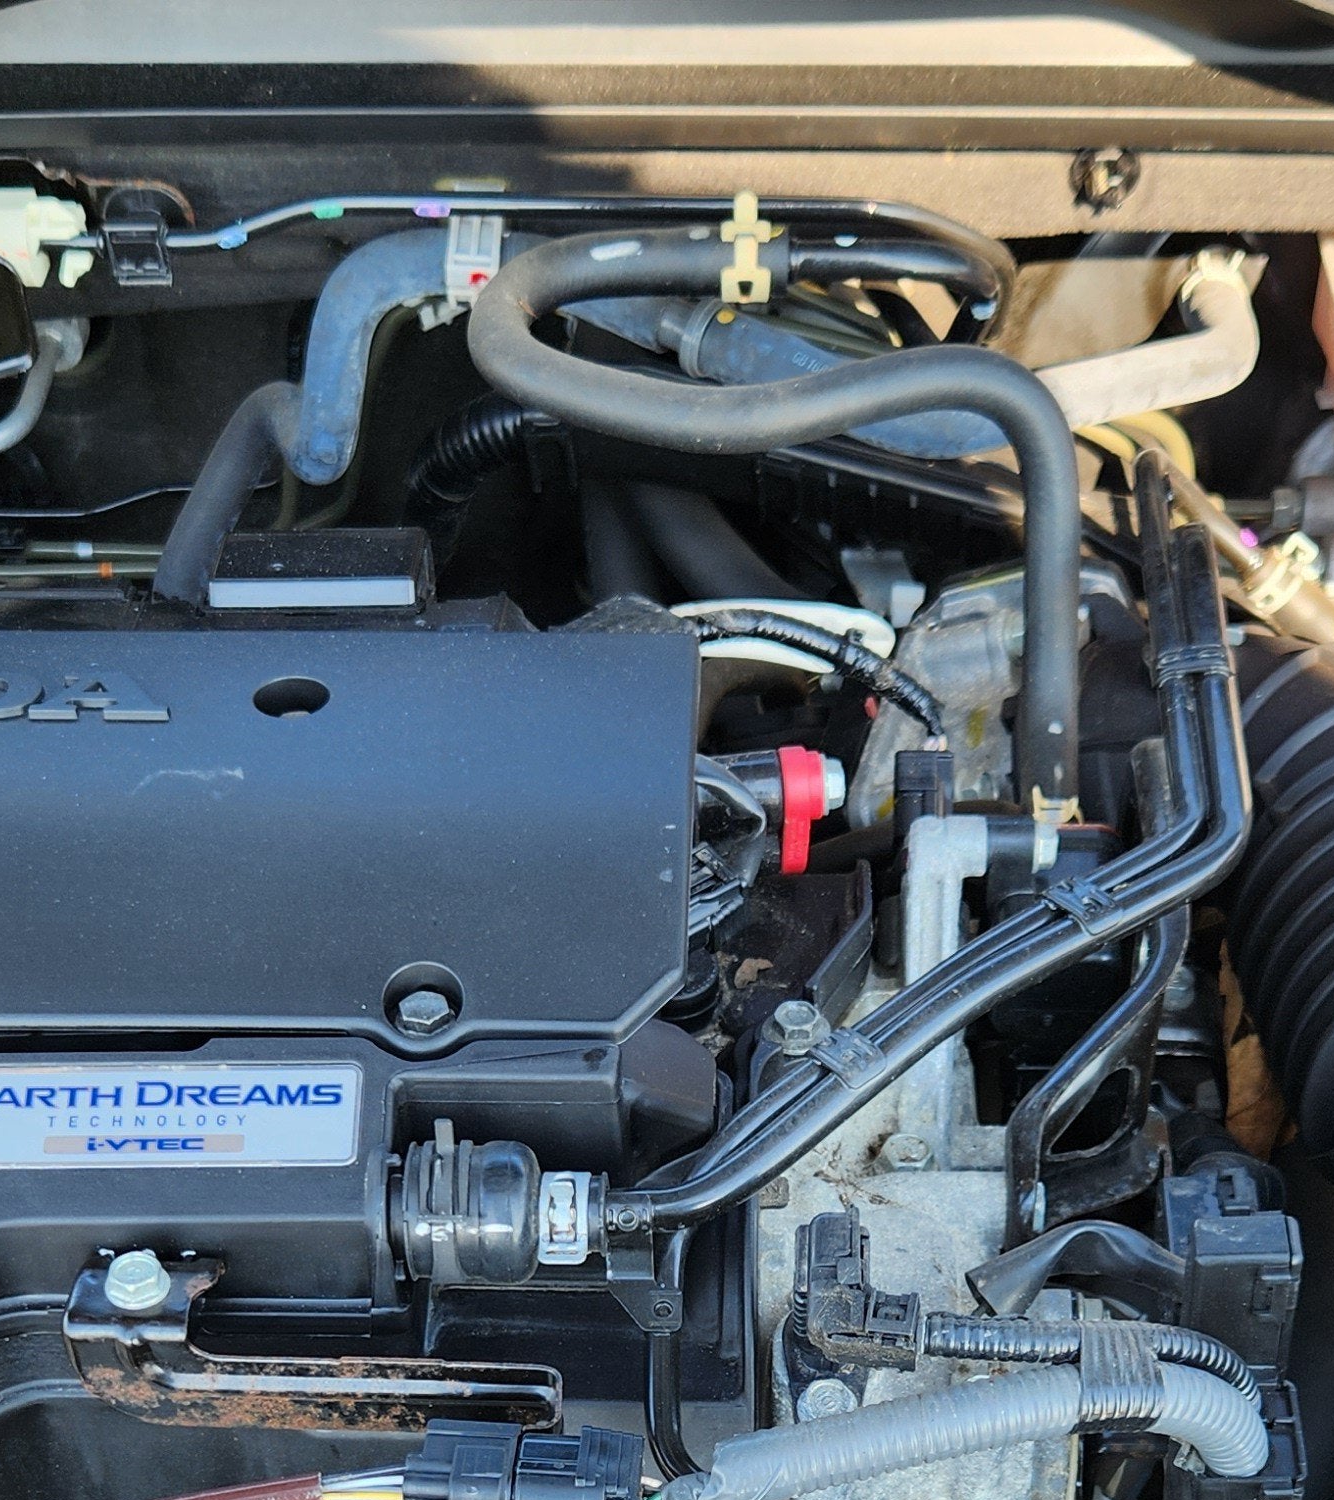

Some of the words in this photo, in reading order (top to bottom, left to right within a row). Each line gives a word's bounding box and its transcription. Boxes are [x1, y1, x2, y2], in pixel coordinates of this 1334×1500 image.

[135, 1081, 343, 1108] DREAMS
[47, 1114, 247, 1128] TECHNOLOGY
[86, 1137, 206, 1152] i-VTEC
